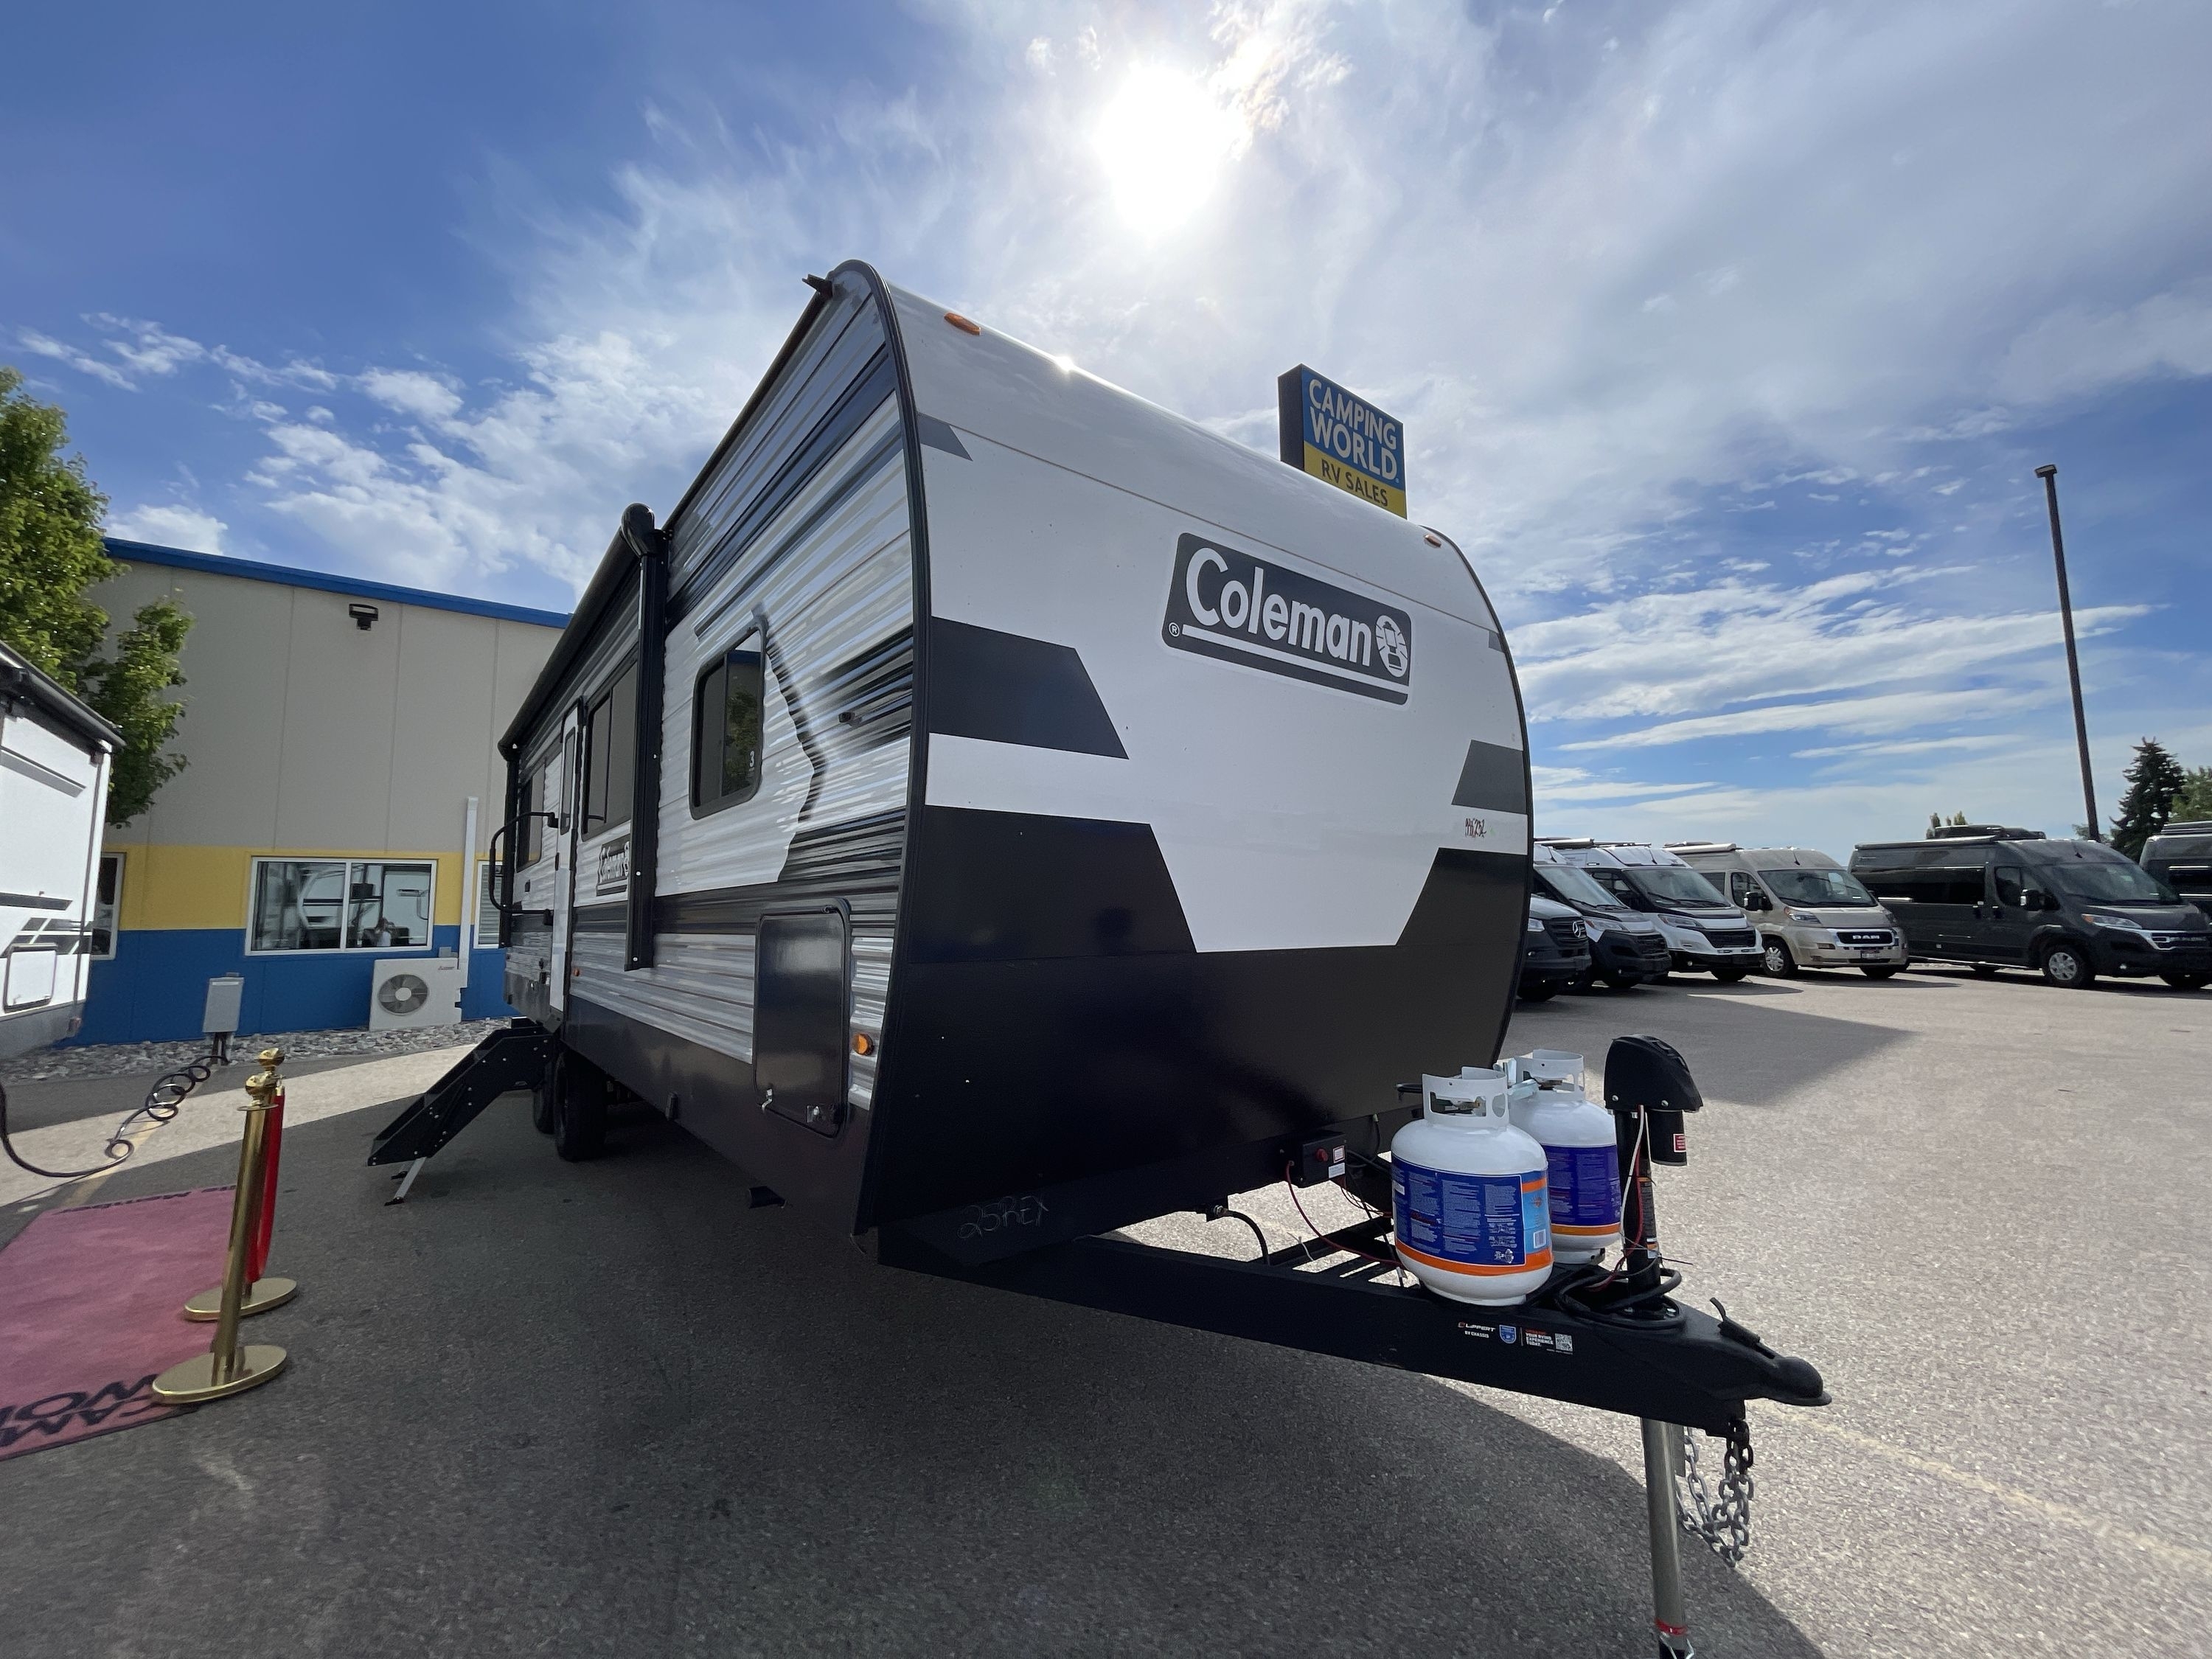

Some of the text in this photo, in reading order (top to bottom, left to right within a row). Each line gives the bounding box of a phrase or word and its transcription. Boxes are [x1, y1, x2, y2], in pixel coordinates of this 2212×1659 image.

[1309, 379, 1397, 450] CAMPING
[1310, 406, 1397, 480] WORLD
[1321, 458, 1388, 507] RV SALES
[1186, 547, 1372, 667] Coleman
[1465, 1323, 1496, 1332] LIPPERT
